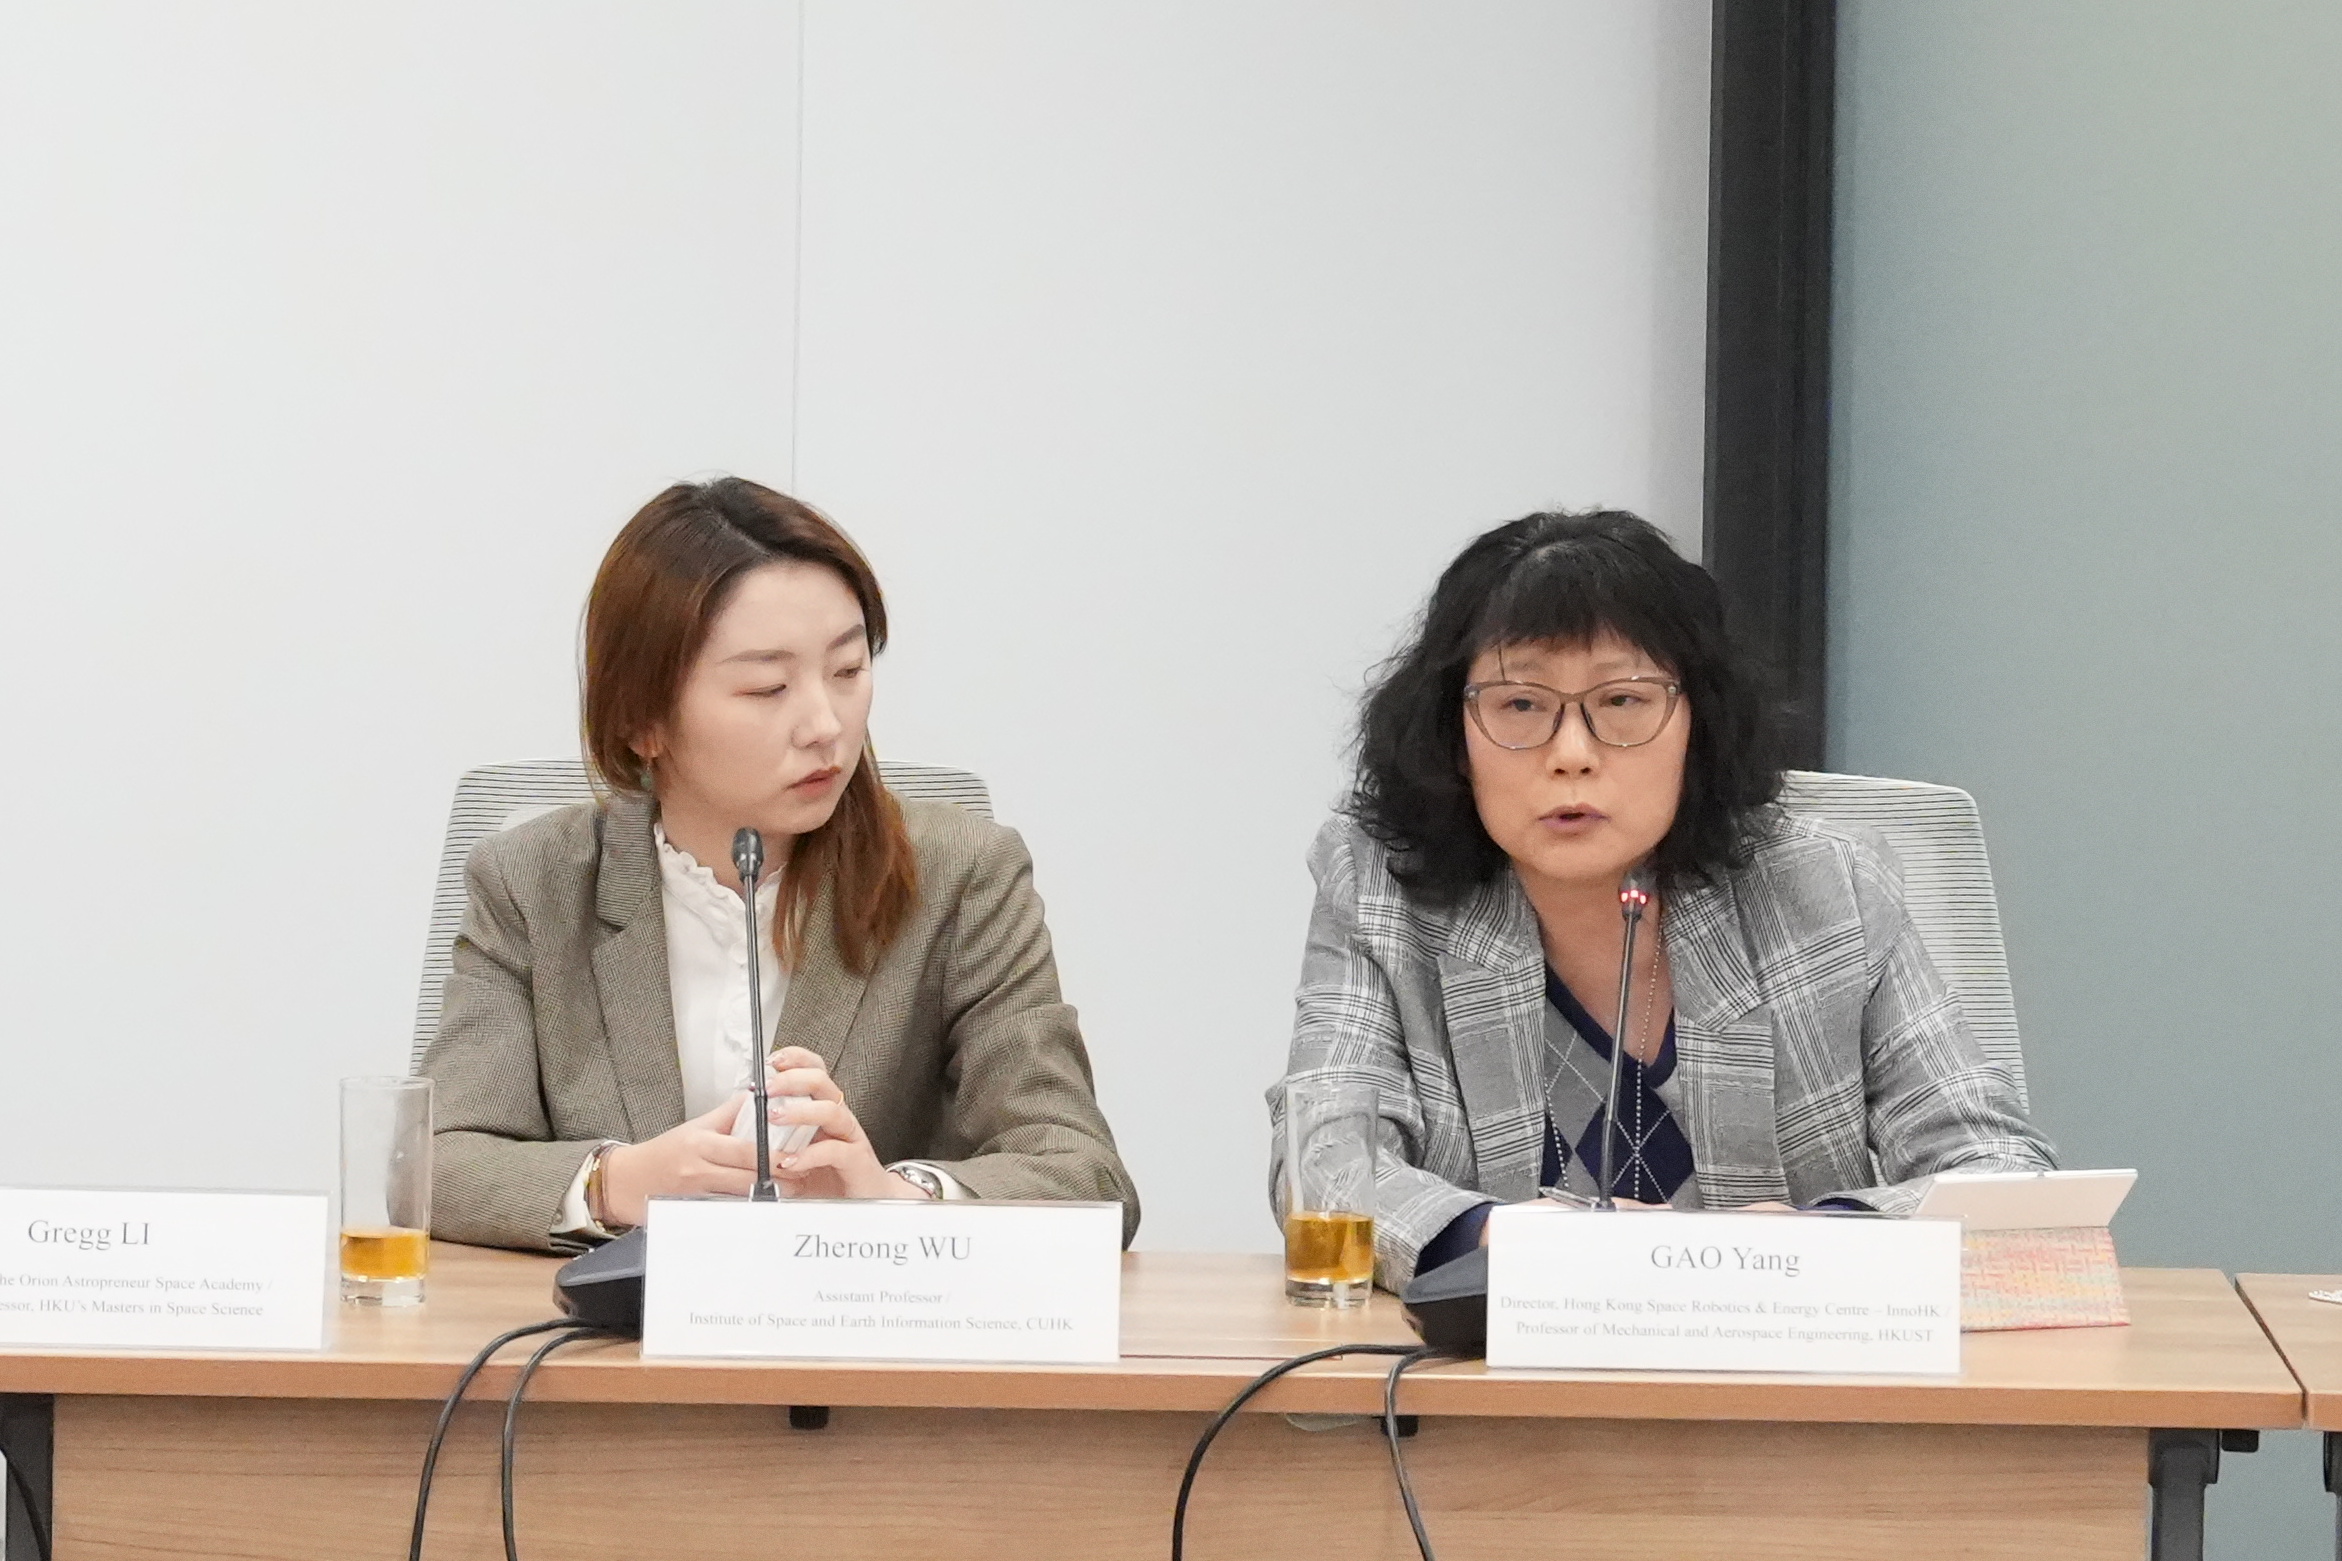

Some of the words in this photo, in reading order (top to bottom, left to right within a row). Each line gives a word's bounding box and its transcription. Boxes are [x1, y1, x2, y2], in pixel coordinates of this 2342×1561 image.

[28, 1220, 111, 1251] Gregg
[121, 1221, 151, 1246] LI
[793, 1234, 908, 1266] Zherong
[918, 1236, 972, 1261] WU
[1651, 1245, 1722, 1269] GAO
[1732, 1247, 1800, 1277] Yang
[19, 1274, 58, 1286] Orion
[62, 1275, 151, 1291] Astropreneur
[155, 1277, 195, 1292] Space
[199, 1278, 263, 1294] Academy
[814, 1290, 874, 1303] Assistant
[880, 1290, 943, 1304] Professor
[1564, 1297, 1601, 1314] Hong
[1606, 1298, 1643, 1314] Kong
[1647, 1299, 1687, 1315] Space
[1692, 1300, 1751, 1313] Robotics
[1755, 1301, 1767, 1314] &
[1773, 1301, 1820, 1318] Energy
[1825, 1303, 1869, 1316] Centre
[1887, 1304, 1941, 1317] InnoHK
[92, 1300, 144, 1313] Masters
[149, 1302, 162, 1315] in
[167, 1302, 207, 1317] Space
[211, 1303, 263, 1316] Science
[690, 1312, 744, 1325] Institute
[748, 1313, 764, 1326] of
[767, 1314, 807, 1330] Space
[811, 1315, 835, 1327] and
[841, 1315, 876, 1327] Earth
[882, 1316, 961, 1329] Information
[1026, 1318, 1073, 1330] CUHK
[1516, 1321, 1579, 1334] Professor
[1583, 1323, 1600, 1335] of
[1603, 1323, 1680, 1337] Mechanical
[1684, 1325, 1709, 1338] and
[1713, 1326, 1783, 1342] Aerospace
[1879, 1329, 1933, 1342] HKUST
